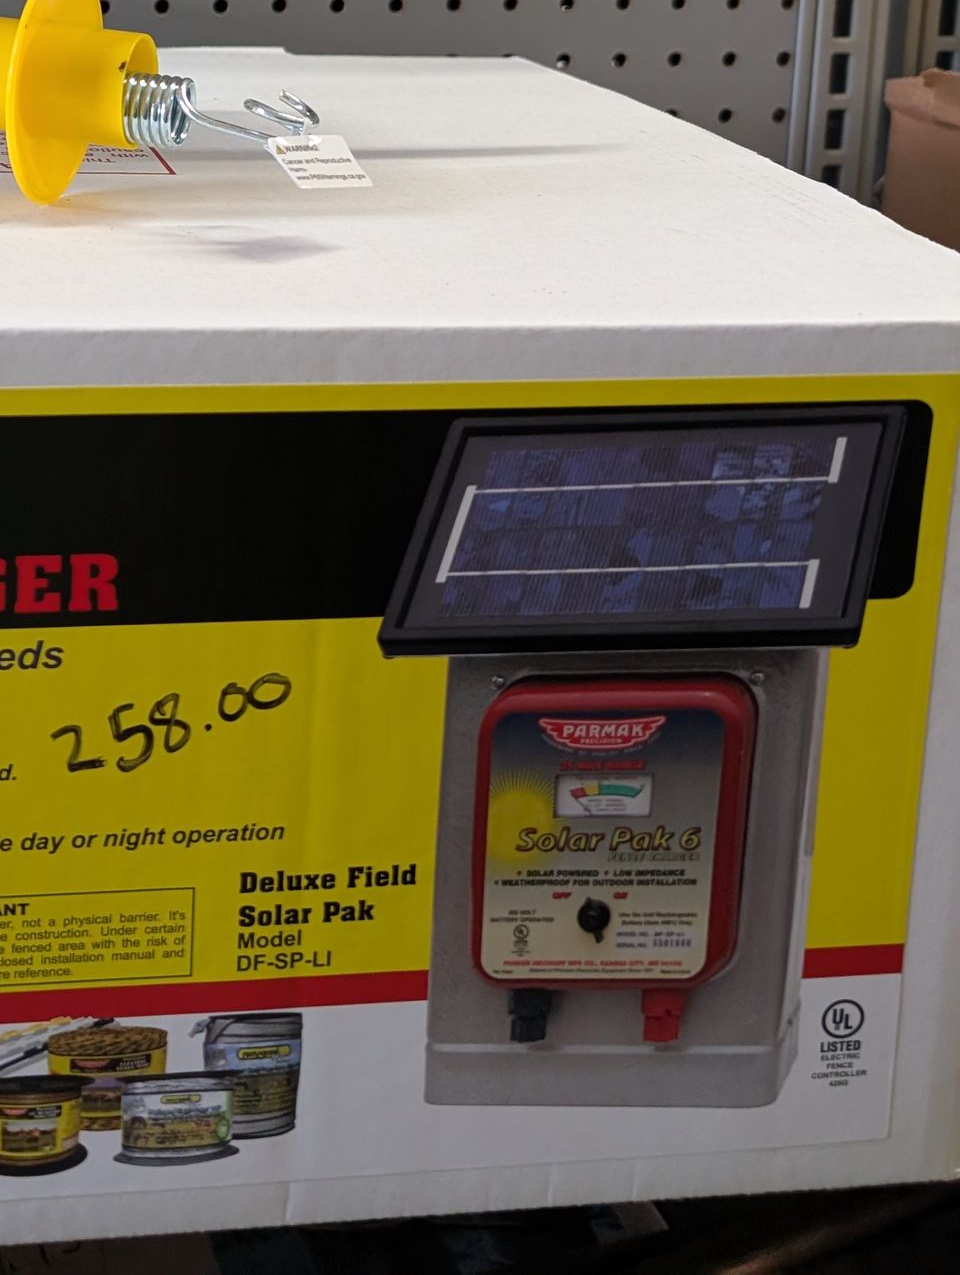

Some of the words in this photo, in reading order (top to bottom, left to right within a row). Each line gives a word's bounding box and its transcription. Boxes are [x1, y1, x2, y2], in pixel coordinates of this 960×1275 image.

[50, 672, 292, 773] 258.00
[515, 826, 605, 853] Solar
[609, 825, 674, 852] Pak
[679, 827, 702, 852] 6
[240, 870, 335, 893] Deluxe
[347, 863, 416, 888] Field
[239, 904, 312, 927] Solar
[322, 899, 374, 923] Pak
[237, 929, 302, 949] Model
[237, 951, 331, 972] DF-SP-LI
[820, 1040, 862, 1053] LISTED
